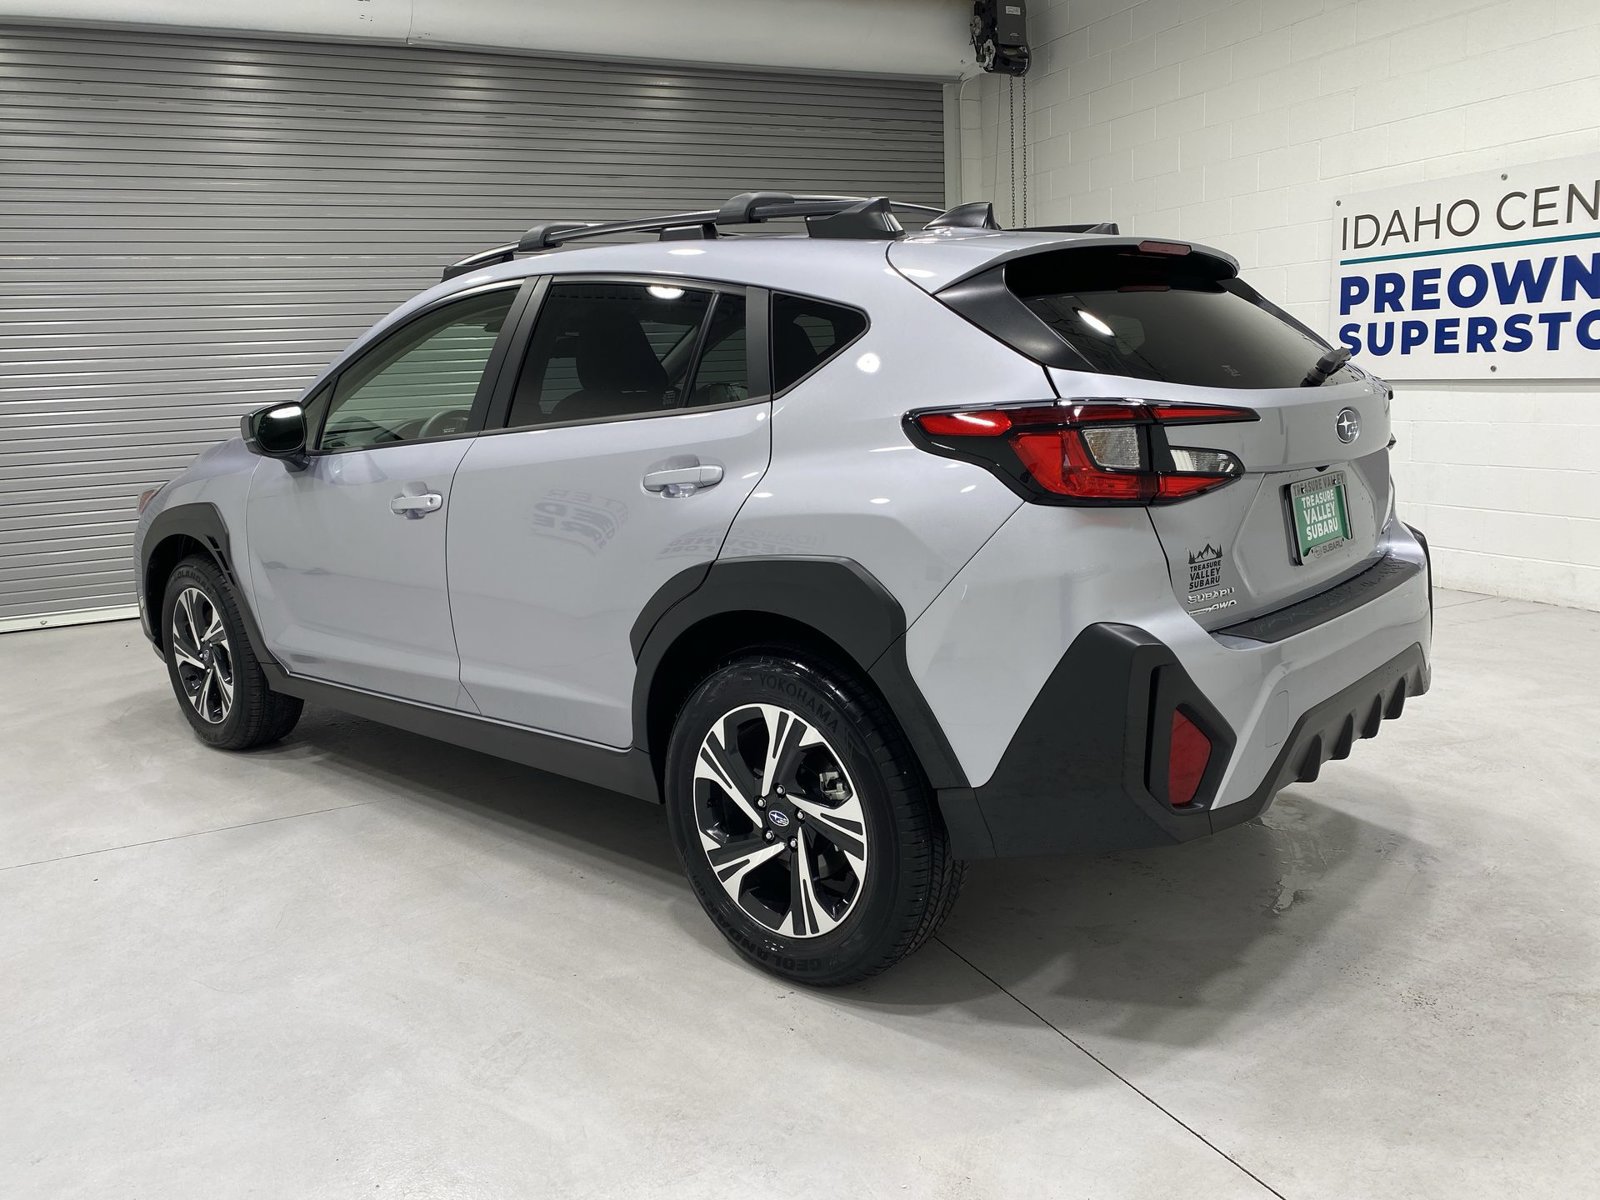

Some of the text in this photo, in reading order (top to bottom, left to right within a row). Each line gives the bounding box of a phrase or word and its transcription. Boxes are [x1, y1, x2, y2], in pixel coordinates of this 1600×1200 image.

[1341, 179, 1600, 251] IDAHO CEN
[1339, 252, 1600, 316] PREOWN
[1338, 309, 1600, 357] SUPERSTO
[1301, 489, 1335, 509] TREASURE
[1303, 501, 1336, 525] VALLEY
[1306, 517, 1339, 541] SUBARU
[1189, 559, 1221, 573] TREASURE
[1189, 567, 1221, 581] VALLEY
[1189, 575, 1220, 590] SUBARU
[1187, 586, 1235, 604] SUBARU
[759, 673, 839, 734] YOKOHAMA
